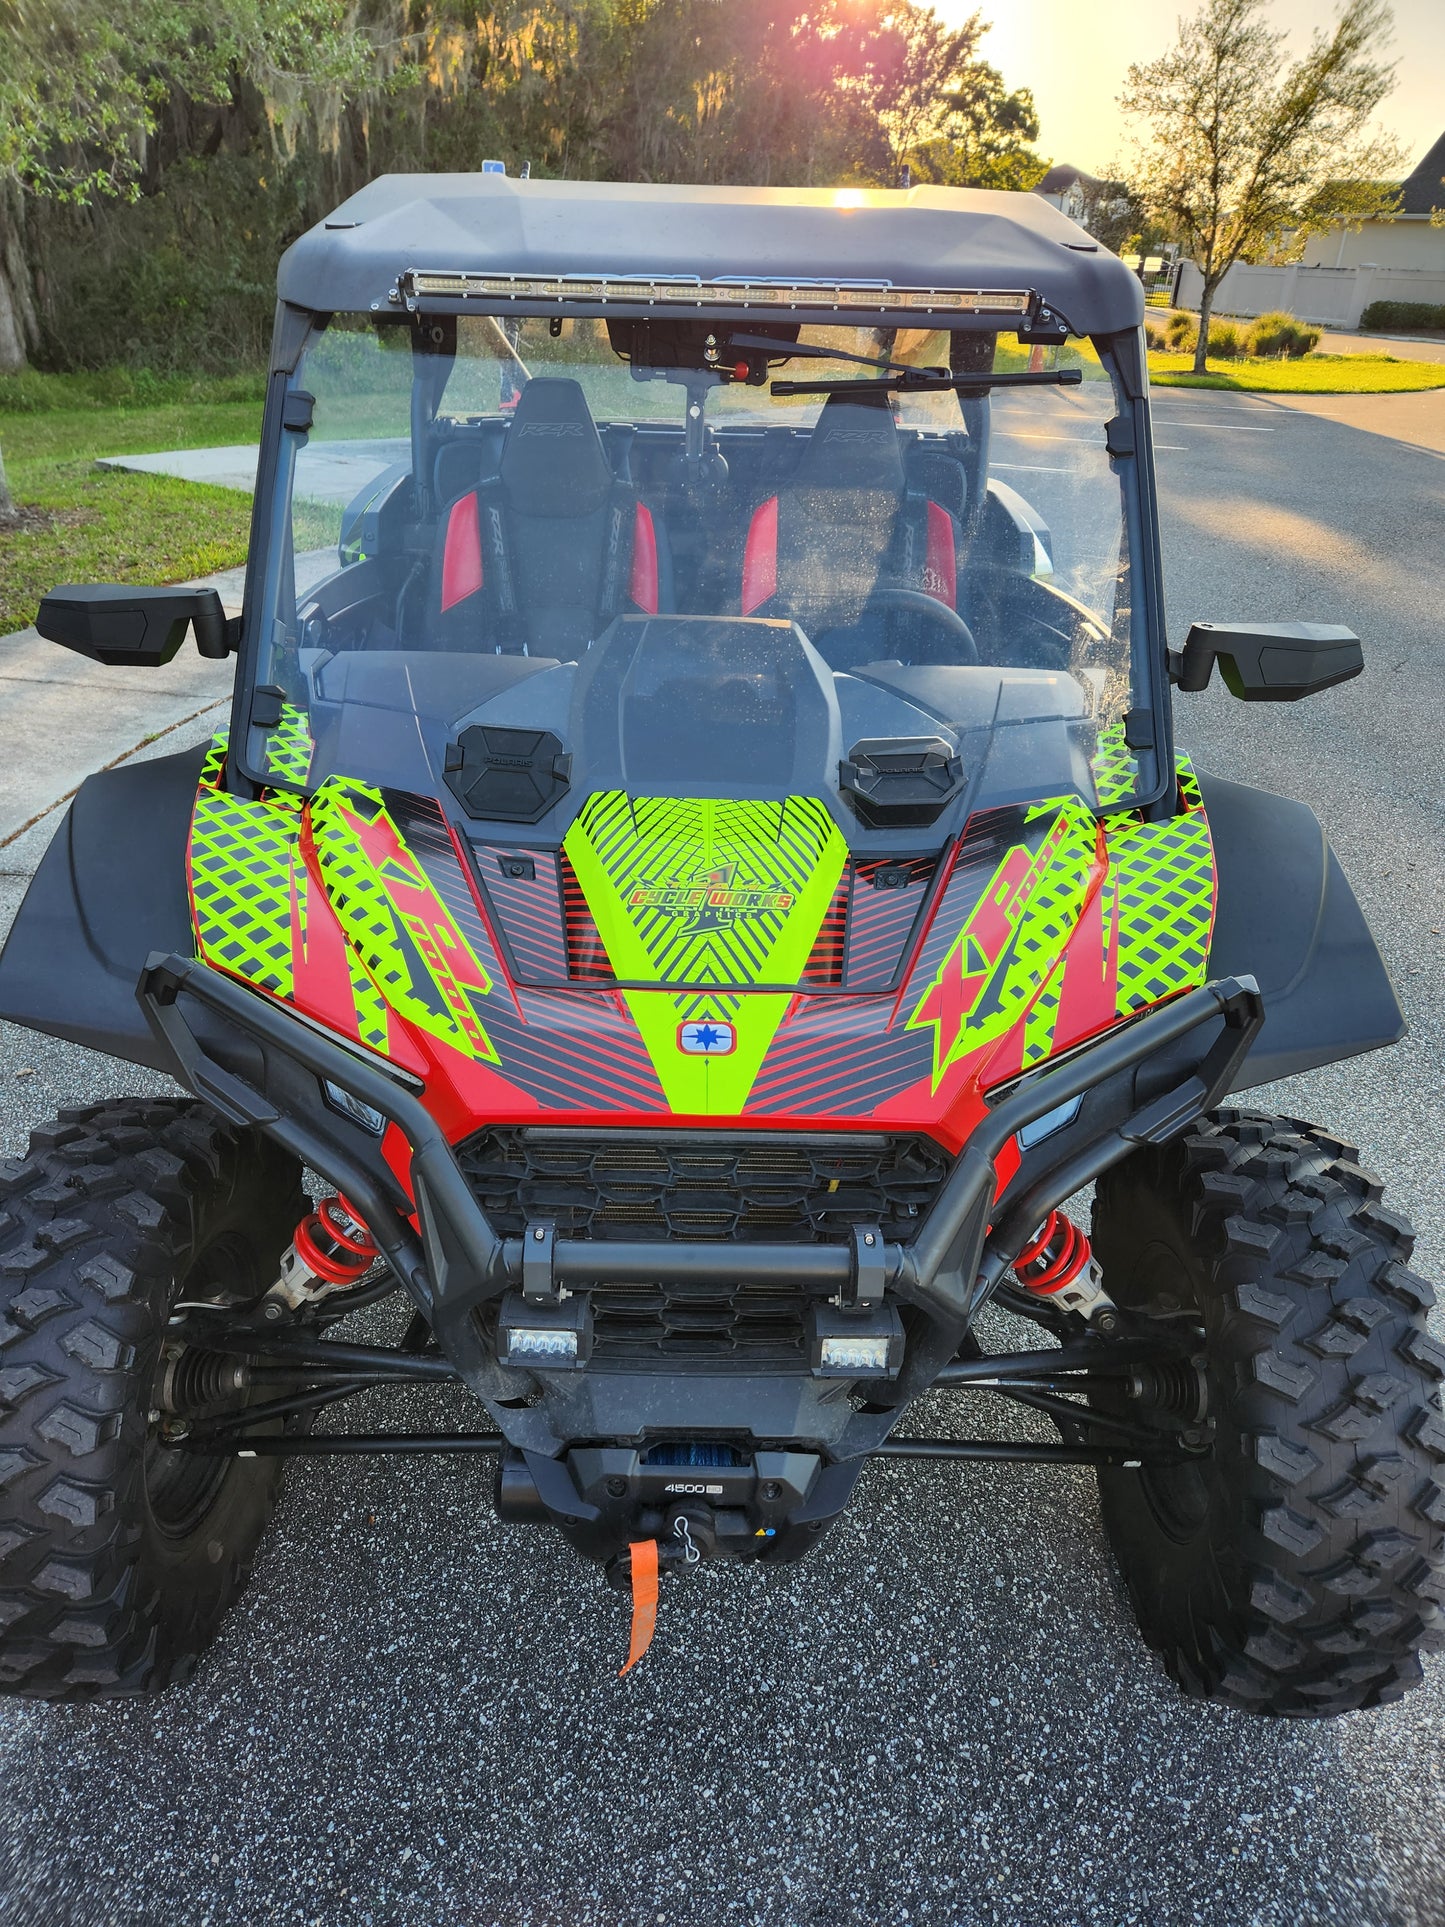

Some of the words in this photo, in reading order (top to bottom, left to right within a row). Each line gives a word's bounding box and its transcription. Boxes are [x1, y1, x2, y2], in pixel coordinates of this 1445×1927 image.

[518, 422, 584, 437] RZR
[824, 429, 889, 444] RZR
[484, 756, 534, 768] POLARIS
[878, 766, 926, 774] POLARIS
[630, 889, 702, 905] CYCLE
[709, 891, 793, 909] WORKS
[671, 909, 753, 919] GRAPHICS
[665, 1484, 705, 1494] 4500
